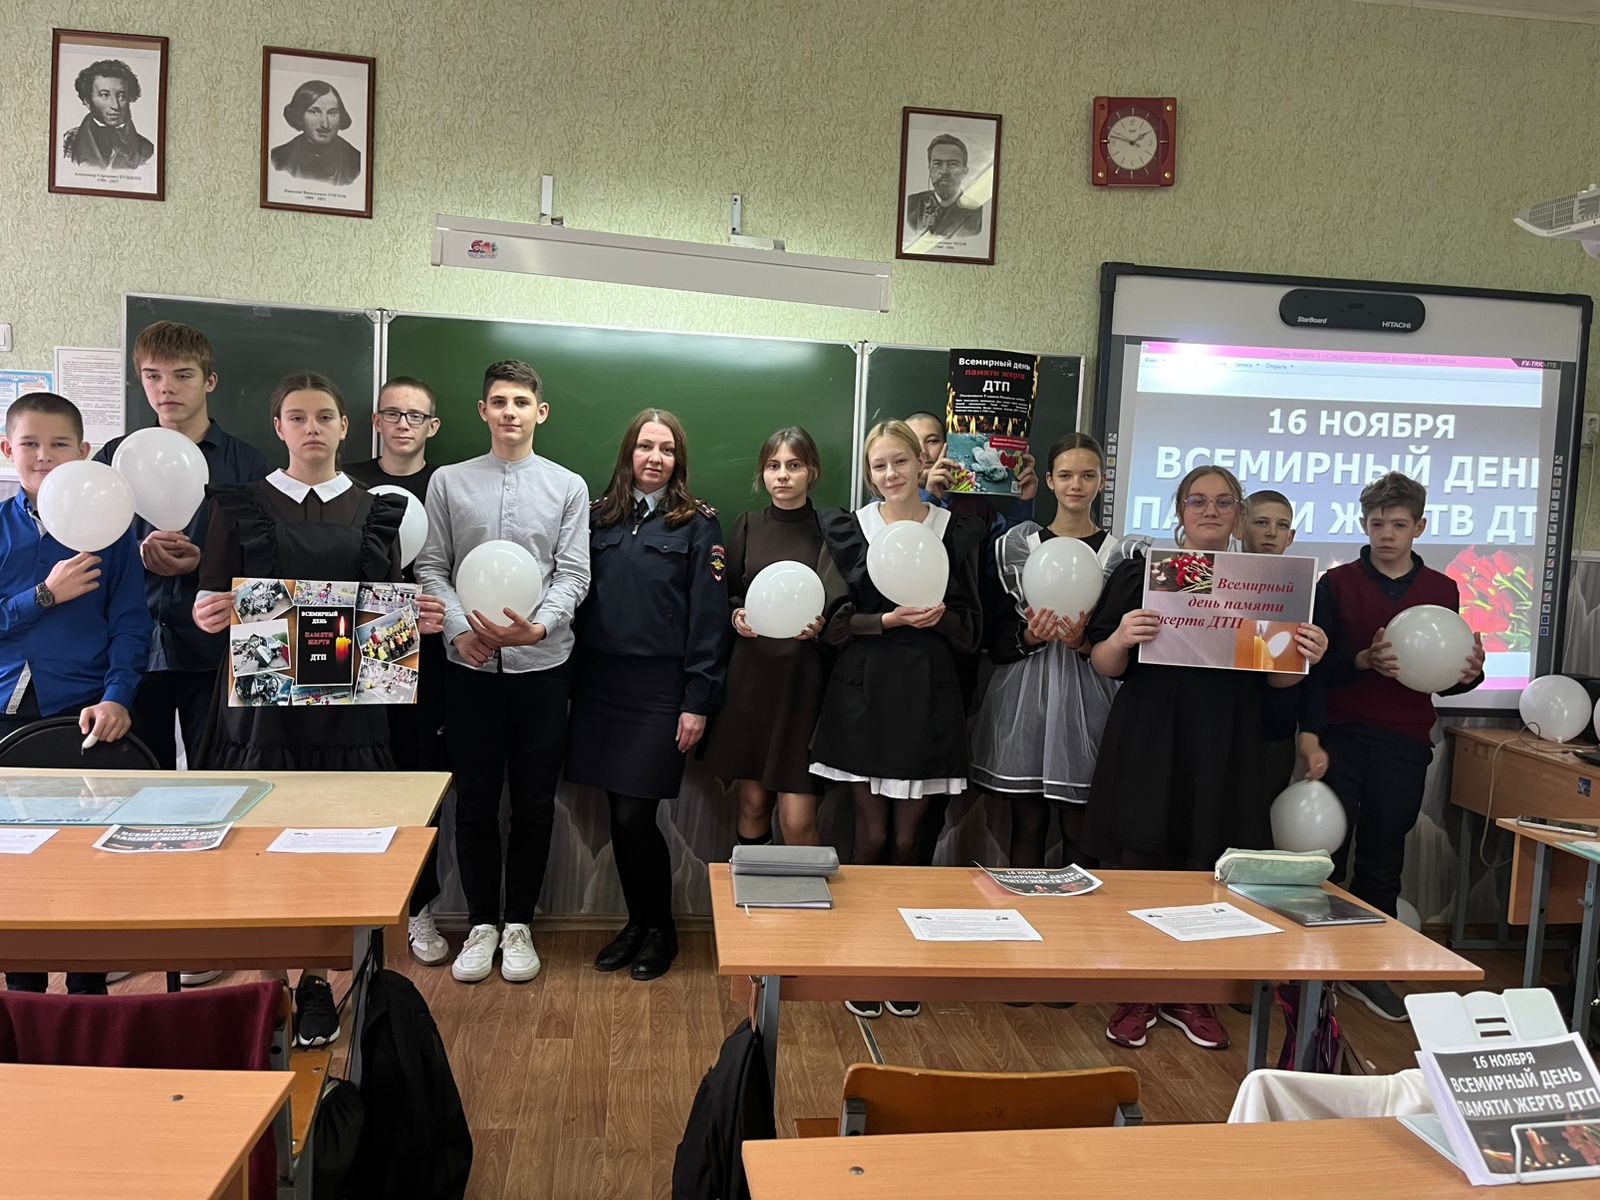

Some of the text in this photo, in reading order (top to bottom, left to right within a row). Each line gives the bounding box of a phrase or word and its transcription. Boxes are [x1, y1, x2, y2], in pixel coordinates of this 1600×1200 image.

[1297, 315, 1328, 324] StarBoard
[1382, 320, 1412, 329] HITACHI
[958, 358, 1031, 370] Всемирный день
[964, 369, 1025, 380] памяти жертв
[982, 380, 1010, 392] ДТП
[1268, 408, 1456, 439] 16 НОЯБРЯ
[1328, 501, 1475, 537] ЖТВ
[1217, 578, 1295, 594] Всемирный
[1187, 595, 1285, 613] день памяти
[1207, 615, 1244, 630] ДТП
[1472, 1051, 1536, 1070] 16 НОЯБРЯ
[1450, 1067, 1583, 1093] ВСЕМИРНЫЙ ДЕНЬ
[1457, 1087, 1600, 1117] ПАМЯТИ ЖЕРТВ ДТП
